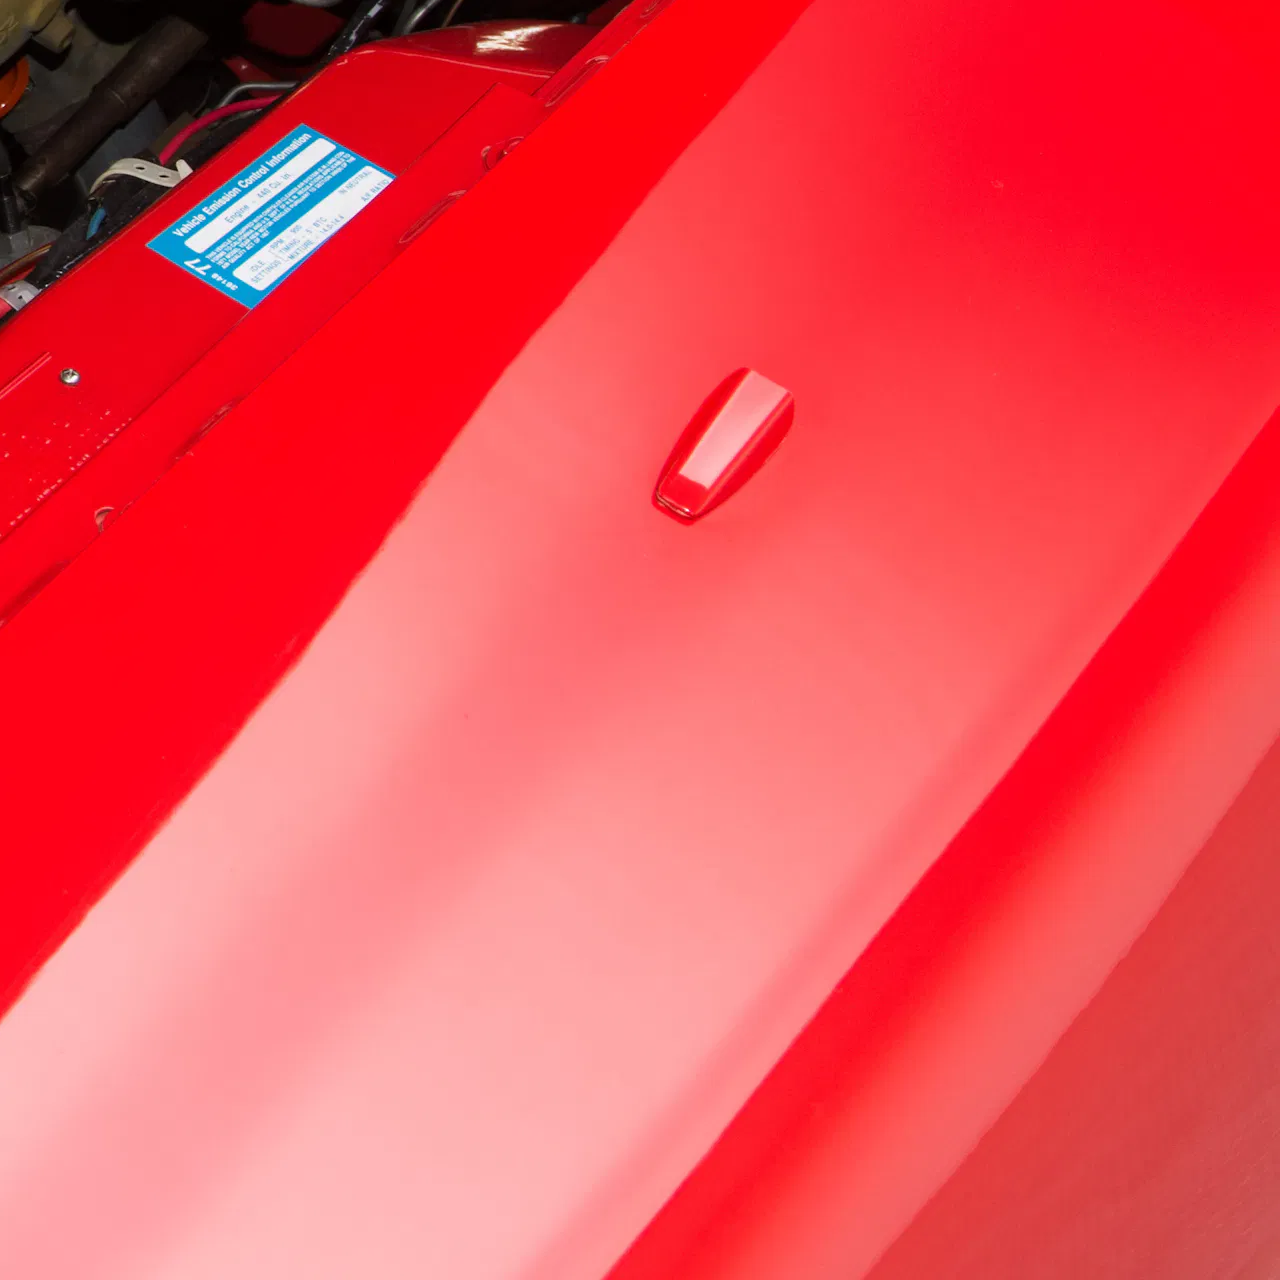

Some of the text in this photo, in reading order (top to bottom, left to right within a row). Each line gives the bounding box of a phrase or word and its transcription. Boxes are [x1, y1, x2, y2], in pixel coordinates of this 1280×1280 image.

[171, 131, 312, 238] Vehicle Emission Control Information
[344, 168, 372, 189] NEUTRAL
[224, 204, 251, 223] Engine
[286, 238, 316, 260] MIXTURE
[249, 258, 283, 283] SETTINGS
